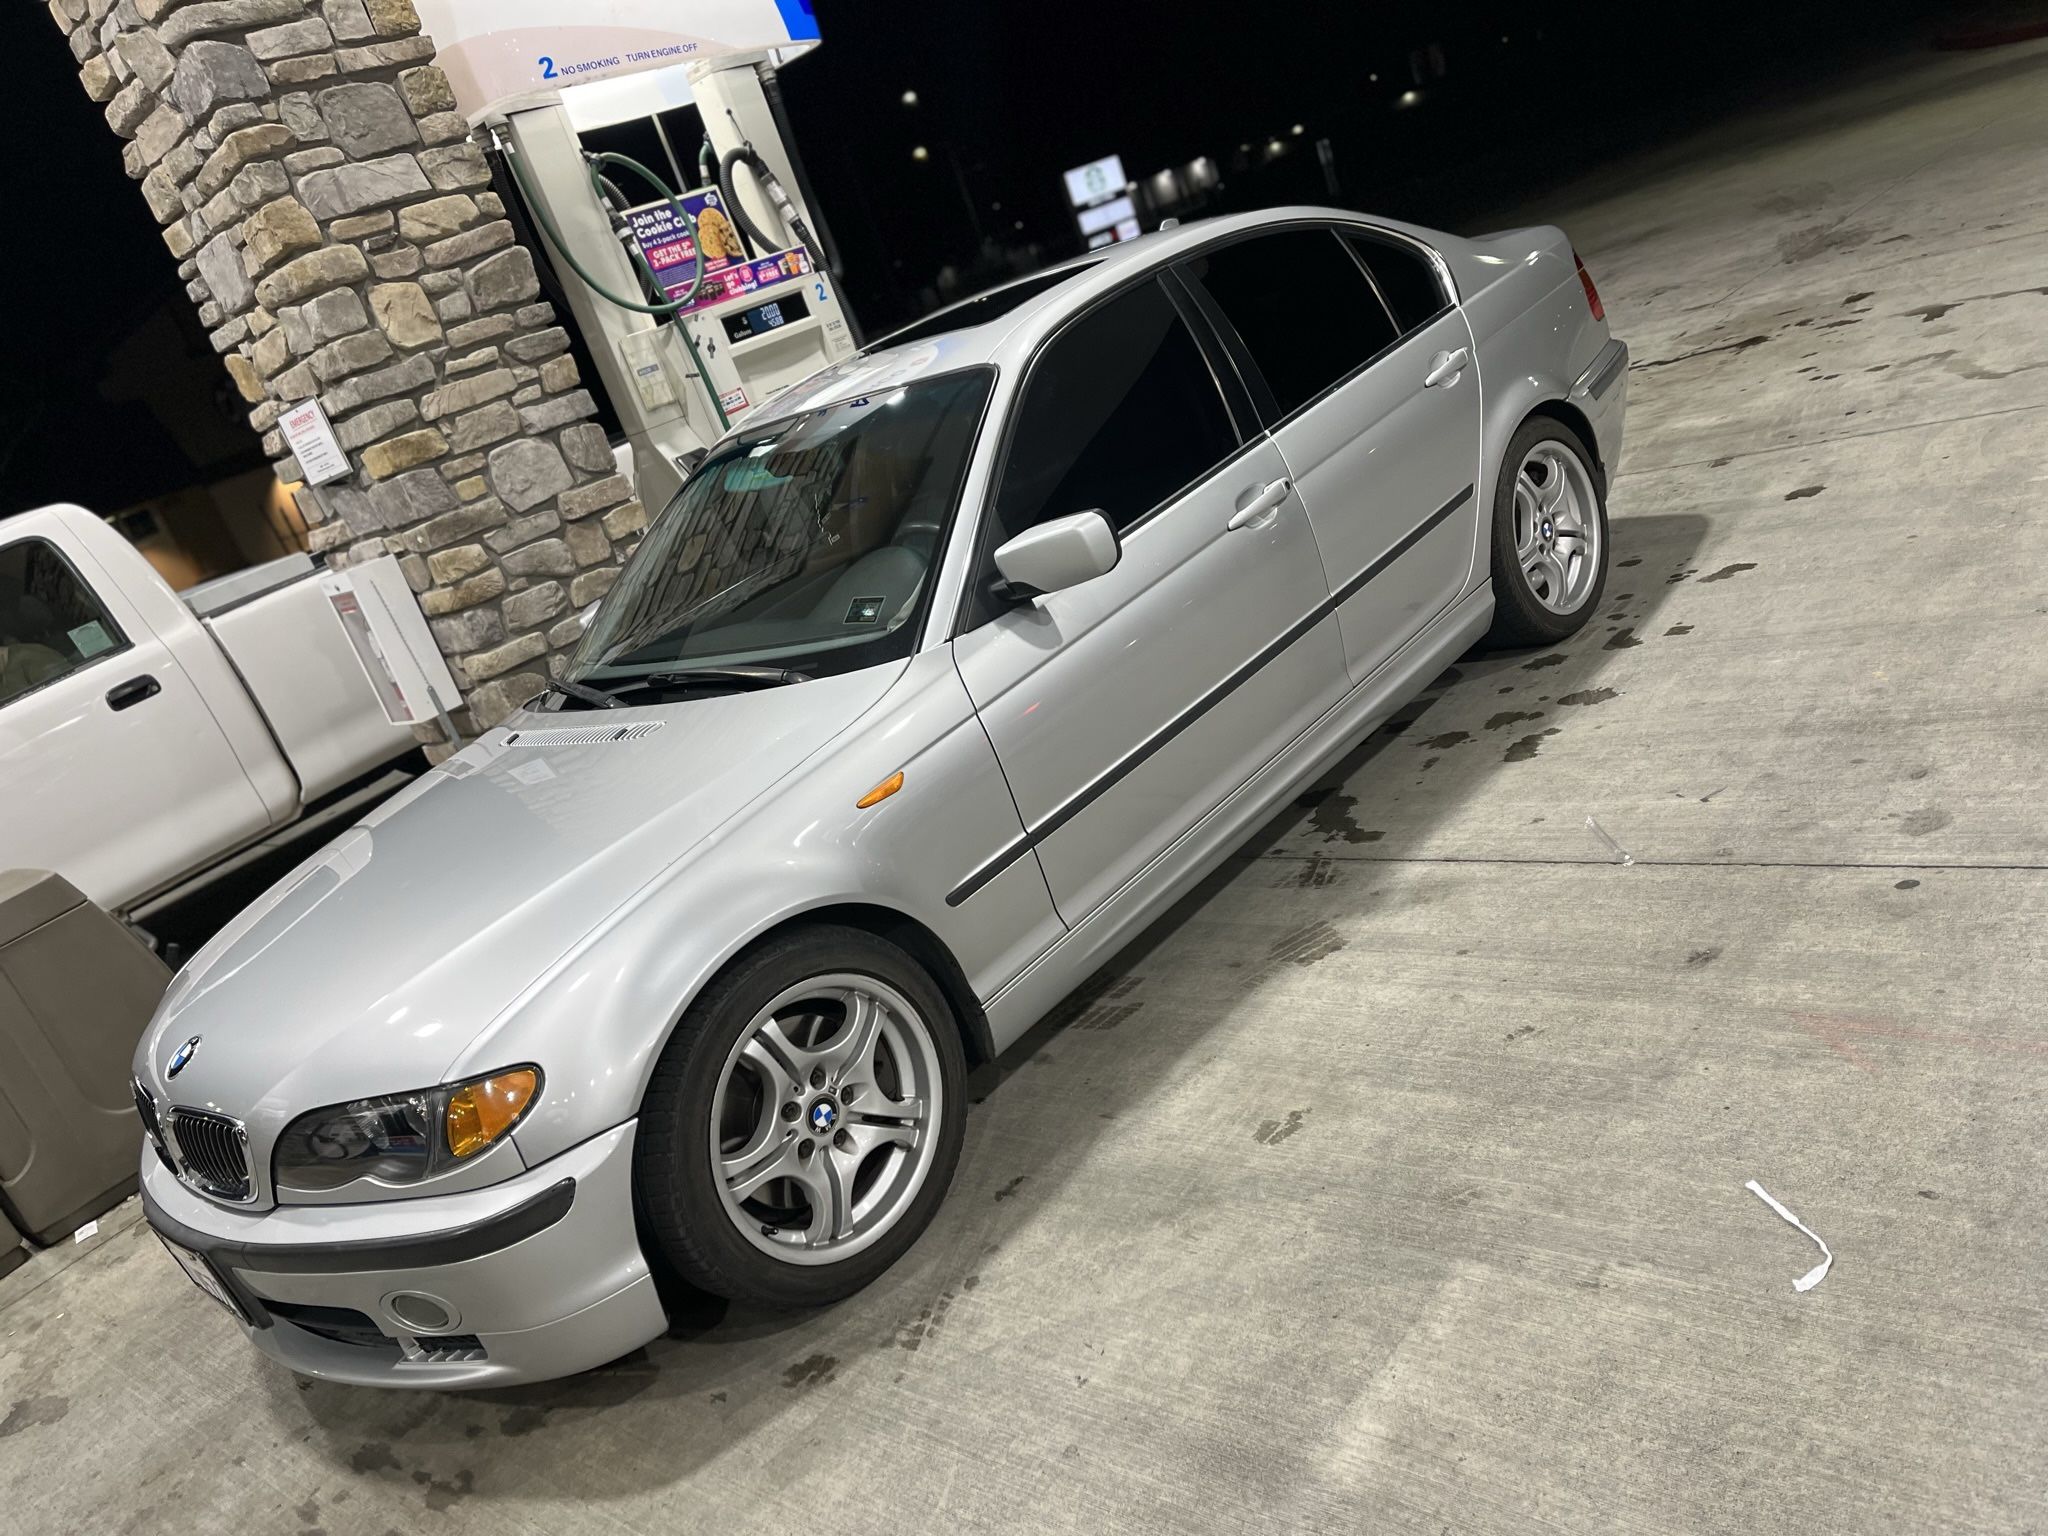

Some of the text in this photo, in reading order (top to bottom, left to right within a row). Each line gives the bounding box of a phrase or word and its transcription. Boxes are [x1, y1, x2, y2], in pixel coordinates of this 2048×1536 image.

[560, 43, 698, 75] NO SMOKING TURN ENGINE OFF
[538, 56, 558, 79] 2
[632, 209, 672, 228] Join the
[636, 213, 697, 238] Cookie Clb
[652, 248, 668, 259] GET
[667, 244, 682, 254] THE
[724, 273, 739, 282] Let's
[726, 281, 735, 290] go
[729, 280, 758, 295] clubbing!
[815, 283, 828, 301] 2
[733, 328, 752, 339] Gallons
